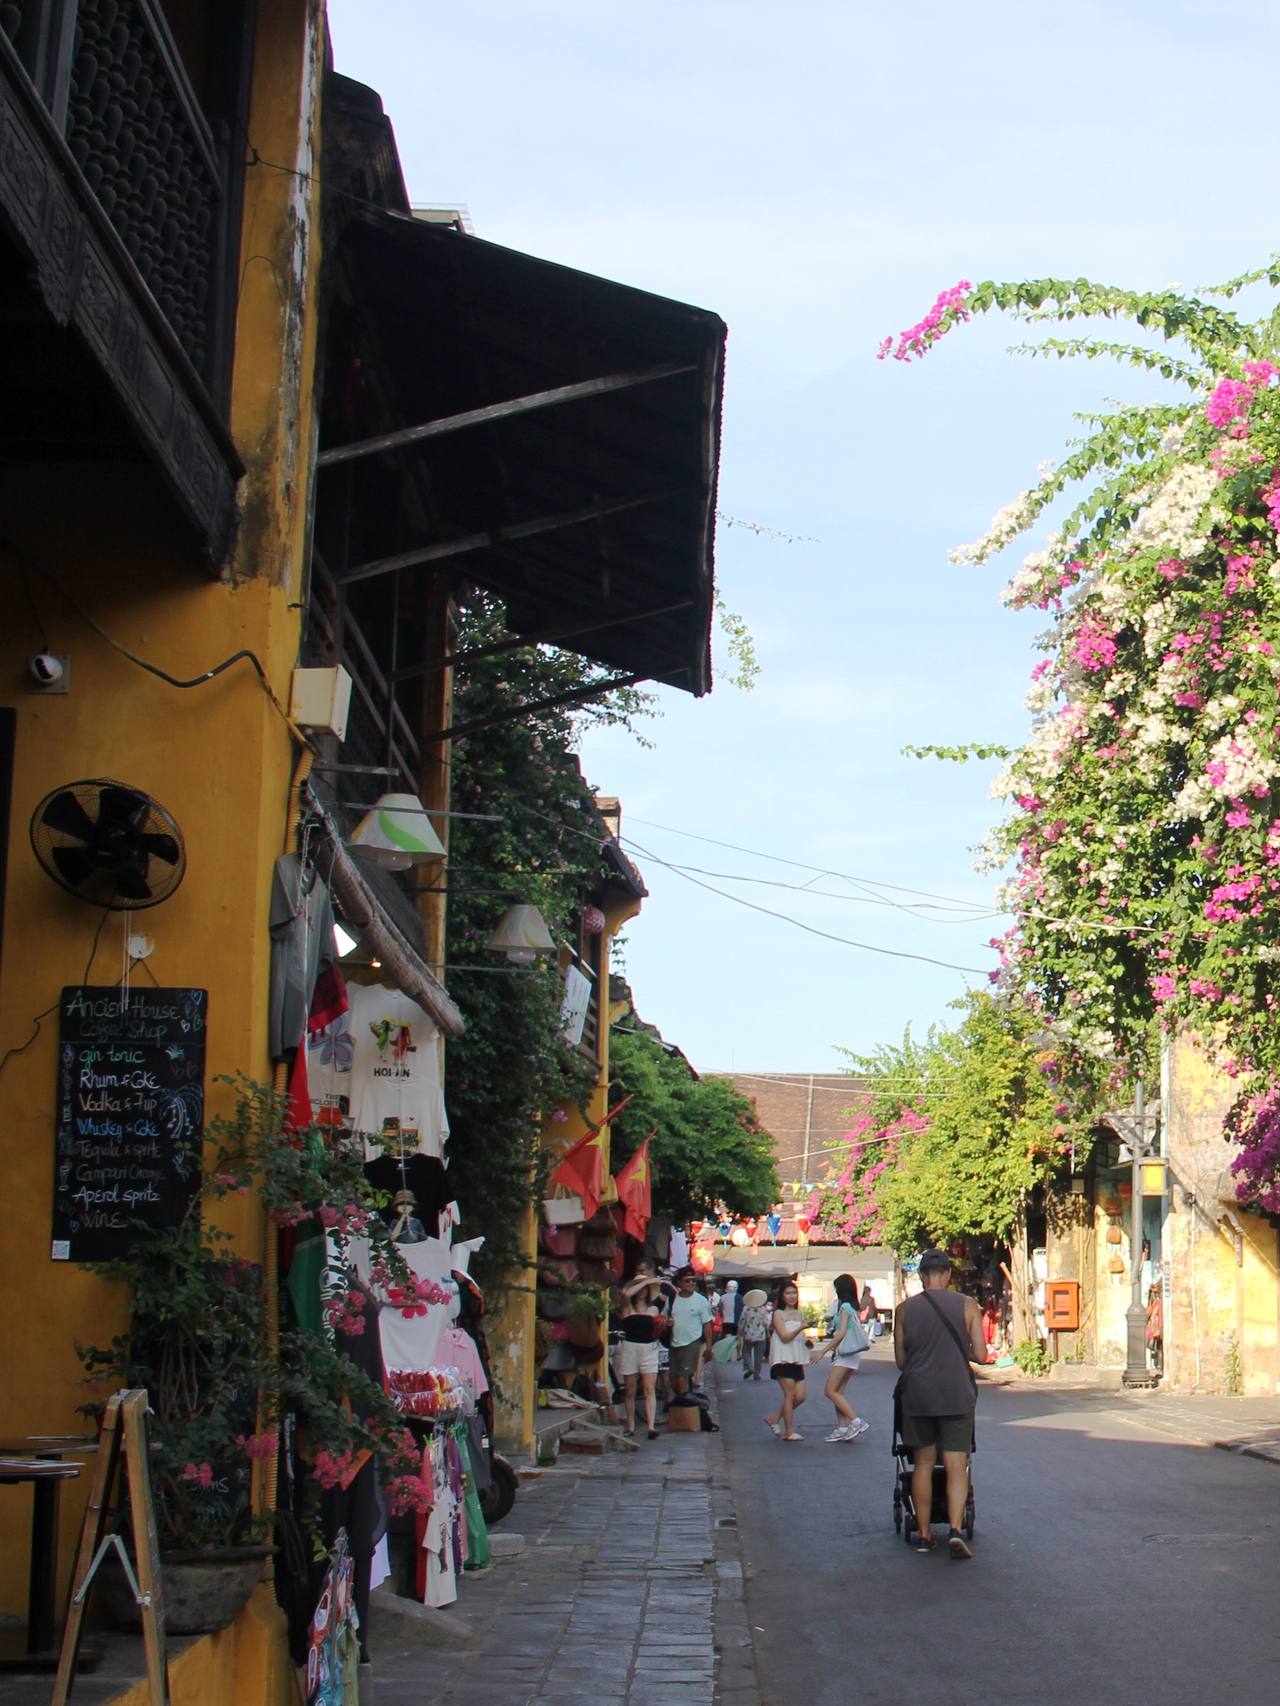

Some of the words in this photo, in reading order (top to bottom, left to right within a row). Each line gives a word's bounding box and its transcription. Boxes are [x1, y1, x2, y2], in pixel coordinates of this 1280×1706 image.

[127, 1020, 167, 1048] Shop
[79, 1045, 104, 1069] gin
[107, 1044, 146, 1063] tonic
[80, 1069, 119, 1089] Rhum
[79, 1090, 122, 1112] Vodka
[77, 1117, 122, 1143] Whiskey
[77, 1163, 127, 1187] Campari
[72, 1183, 119, 1211] Aperol
